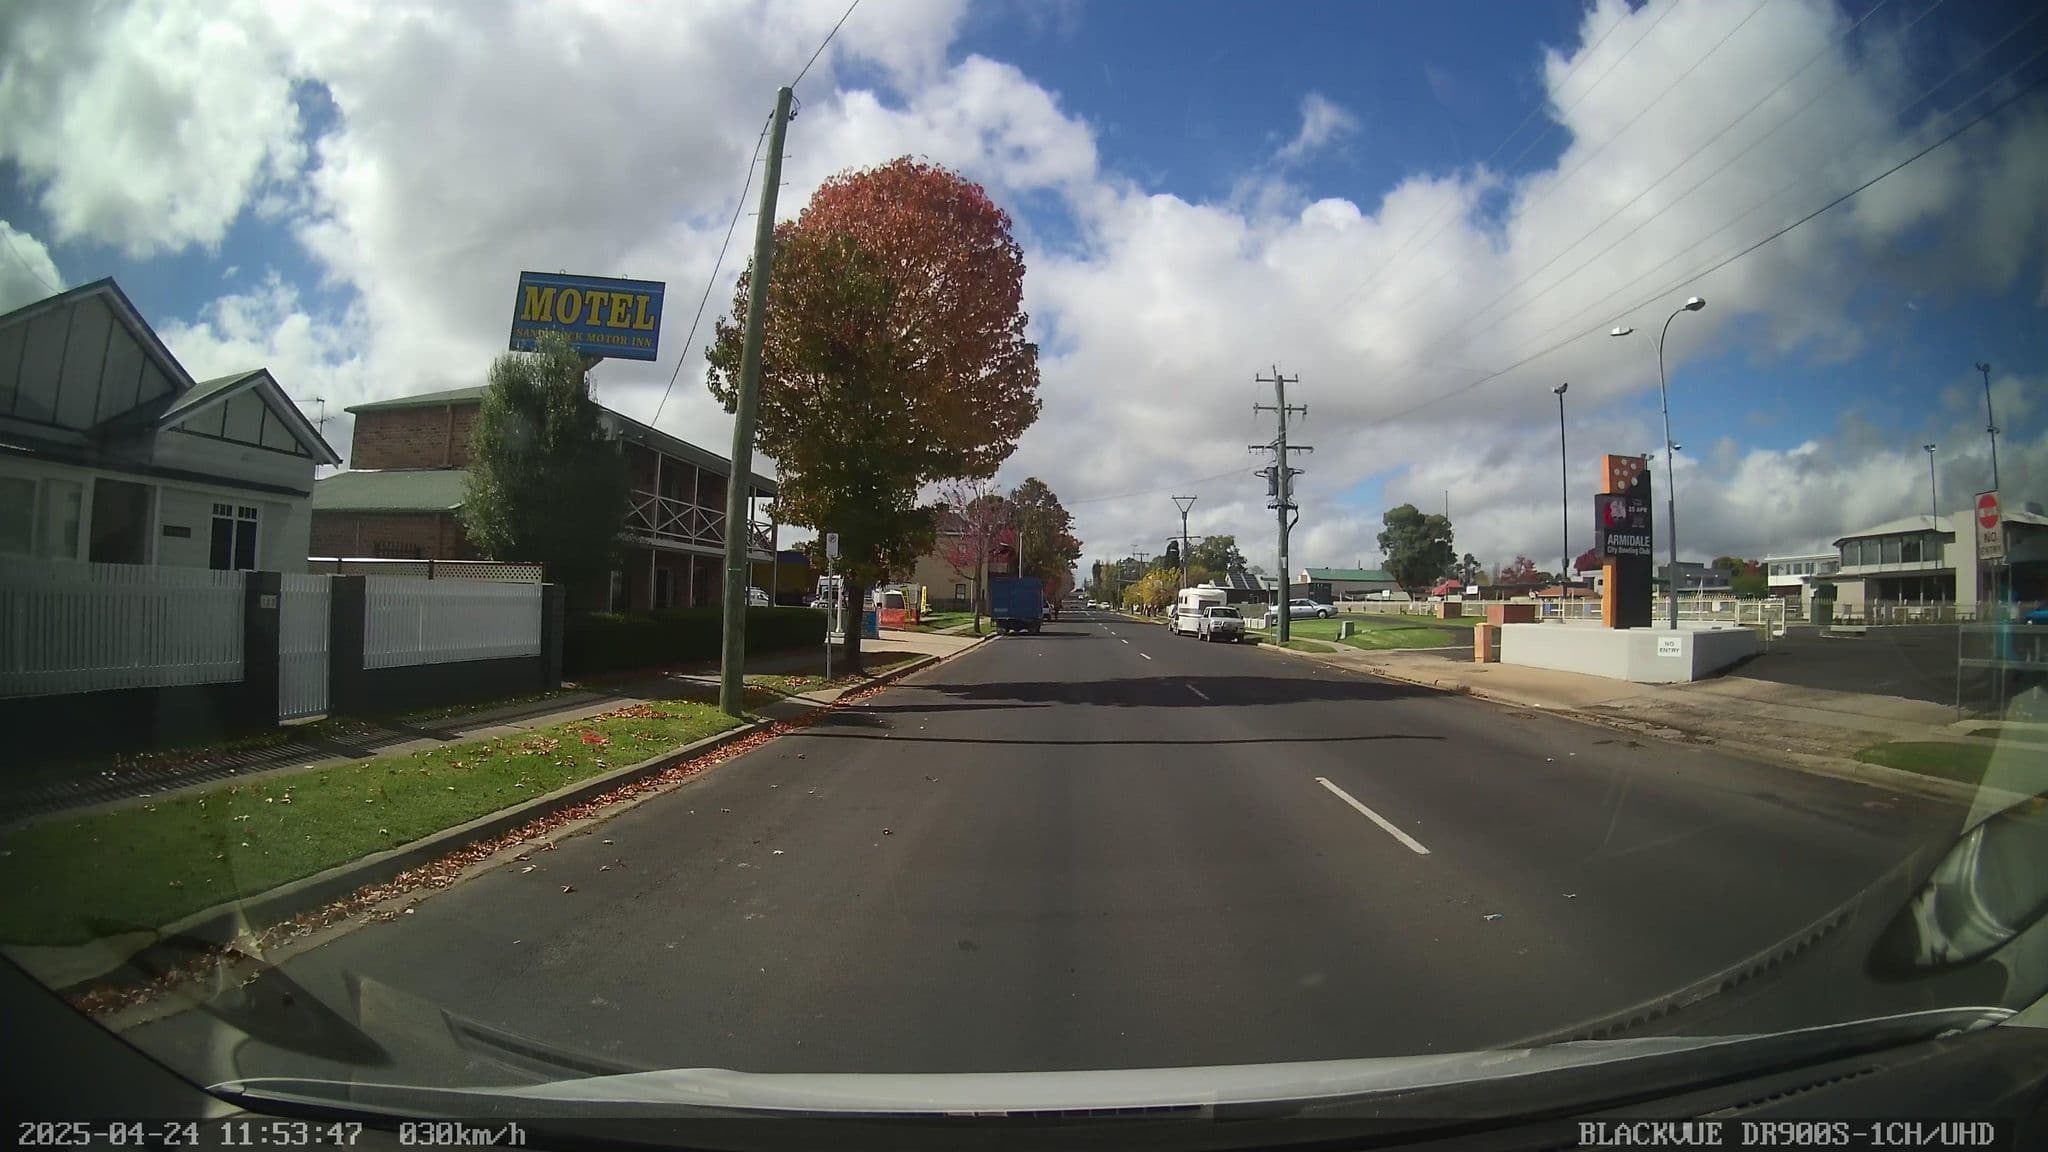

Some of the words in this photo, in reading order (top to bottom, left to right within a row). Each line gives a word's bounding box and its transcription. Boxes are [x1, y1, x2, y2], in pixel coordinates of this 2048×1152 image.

[521, 285, 656, 331] MOTEL
[586, 333, 627, 345] MOTOR
[632, 337, 652, 348] INN
[1607, 533, 1650, 547] ARMIDALE
[1983, 531, 1997, 542] NO
[1607, 545, 1617, 555] City
